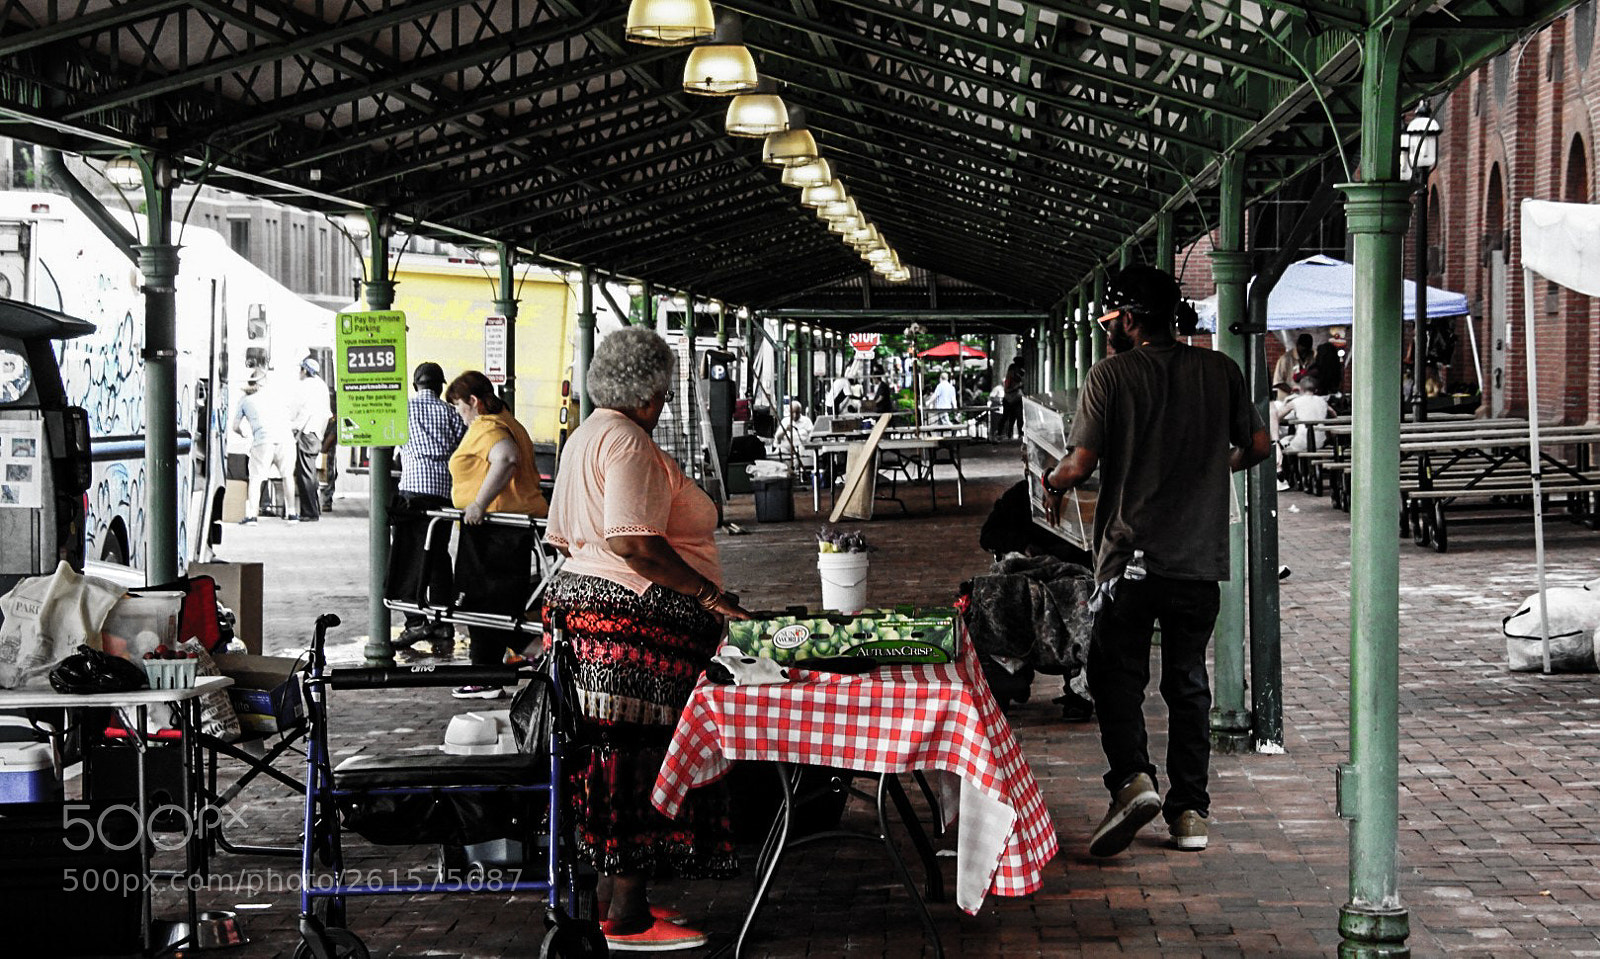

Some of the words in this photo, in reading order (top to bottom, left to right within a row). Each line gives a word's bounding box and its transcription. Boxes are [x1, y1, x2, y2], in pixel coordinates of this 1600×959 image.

[354, 315, 366, 324] Pay
[354, 325, 380, 333] Parking
[851, 332, 879, 343] STOP
[348, 351, 395, 368] 21158
[16, 601, 40, 615] PARI
